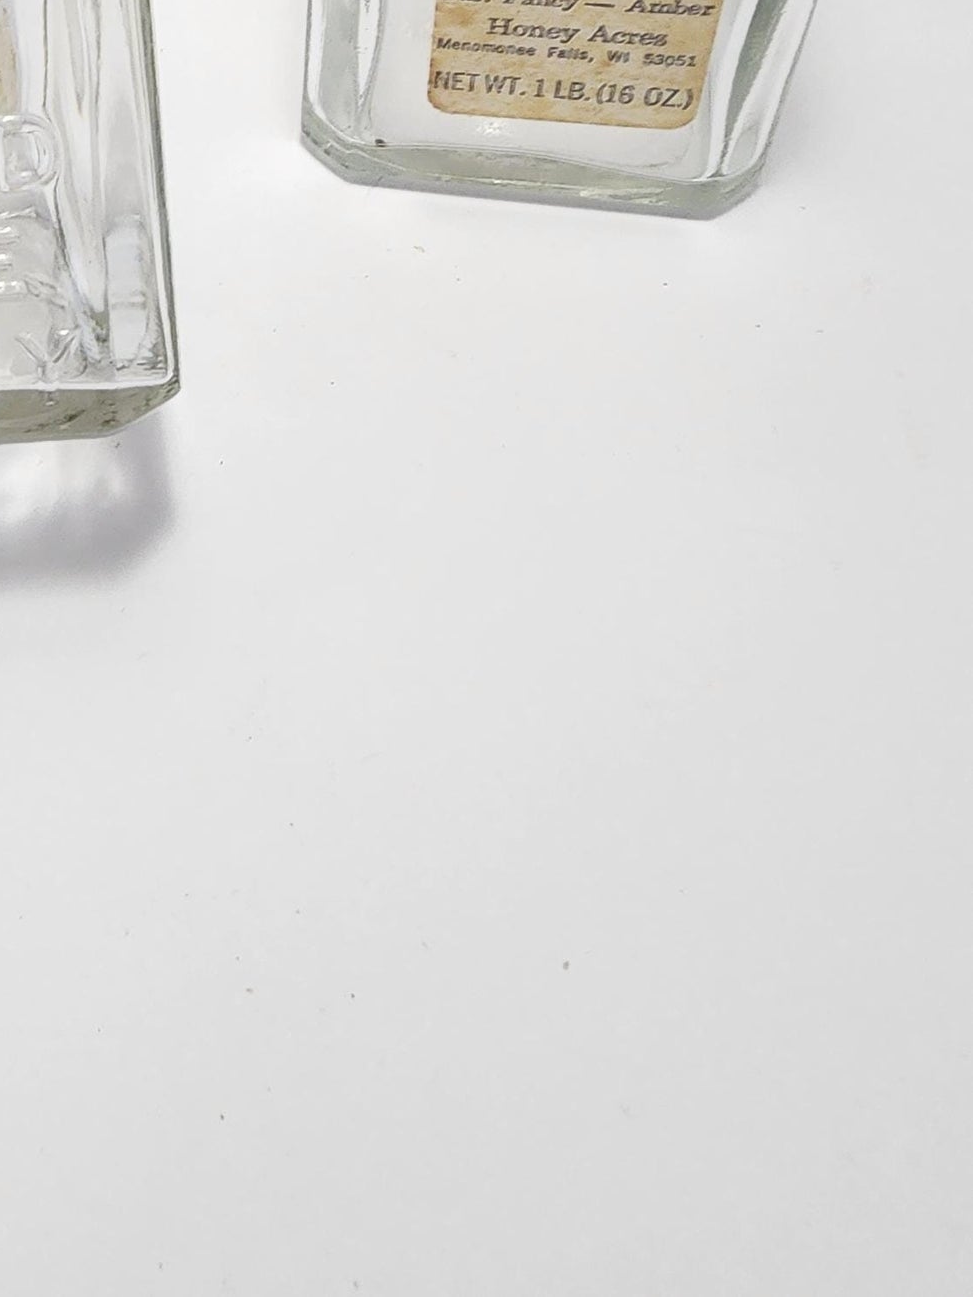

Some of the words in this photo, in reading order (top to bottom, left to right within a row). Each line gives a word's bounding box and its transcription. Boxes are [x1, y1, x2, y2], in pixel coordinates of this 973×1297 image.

[624, 0, 717, 17] Amber
[485, 17, 581, 44] Honey
[587, 24, 670, 48] Acres
[436, 37, 538, 58] Menomonee
[546, 45, 596, 64] Falls,
[606, 49, 631, 64] WI
[432, 70, 481, 94] NET
[483, 73, 528, 98] WT.
[552, 79, 592, 103] LB.
